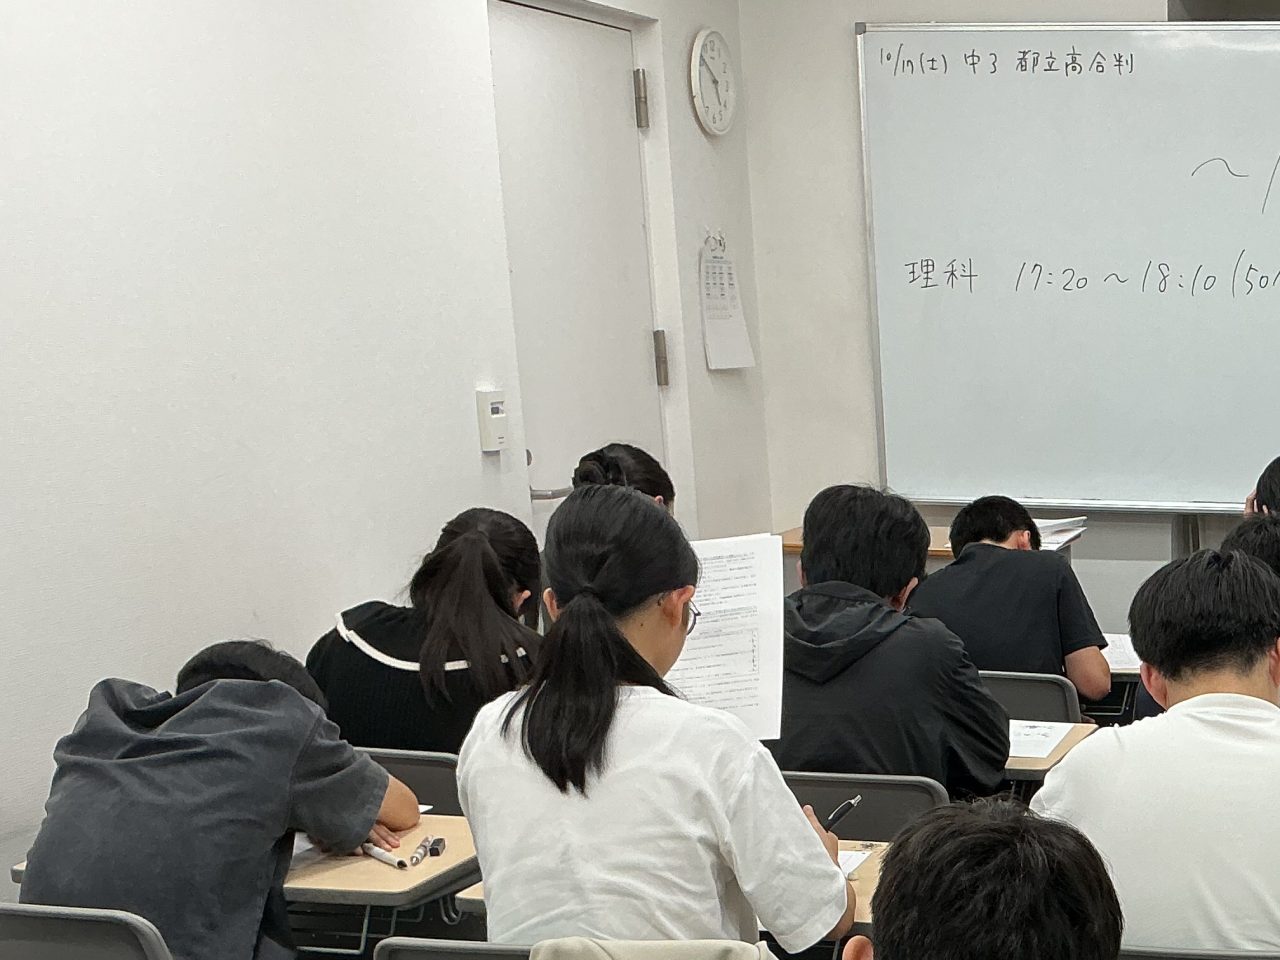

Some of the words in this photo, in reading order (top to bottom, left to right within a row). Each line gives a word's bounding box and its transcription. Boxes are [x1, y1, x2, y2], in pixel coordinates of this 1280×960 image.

[964, 48, 998, 75] 中3
[1015, 45, 1135, 77] 都立高合判
[904, 258, 979, 293] 理科
